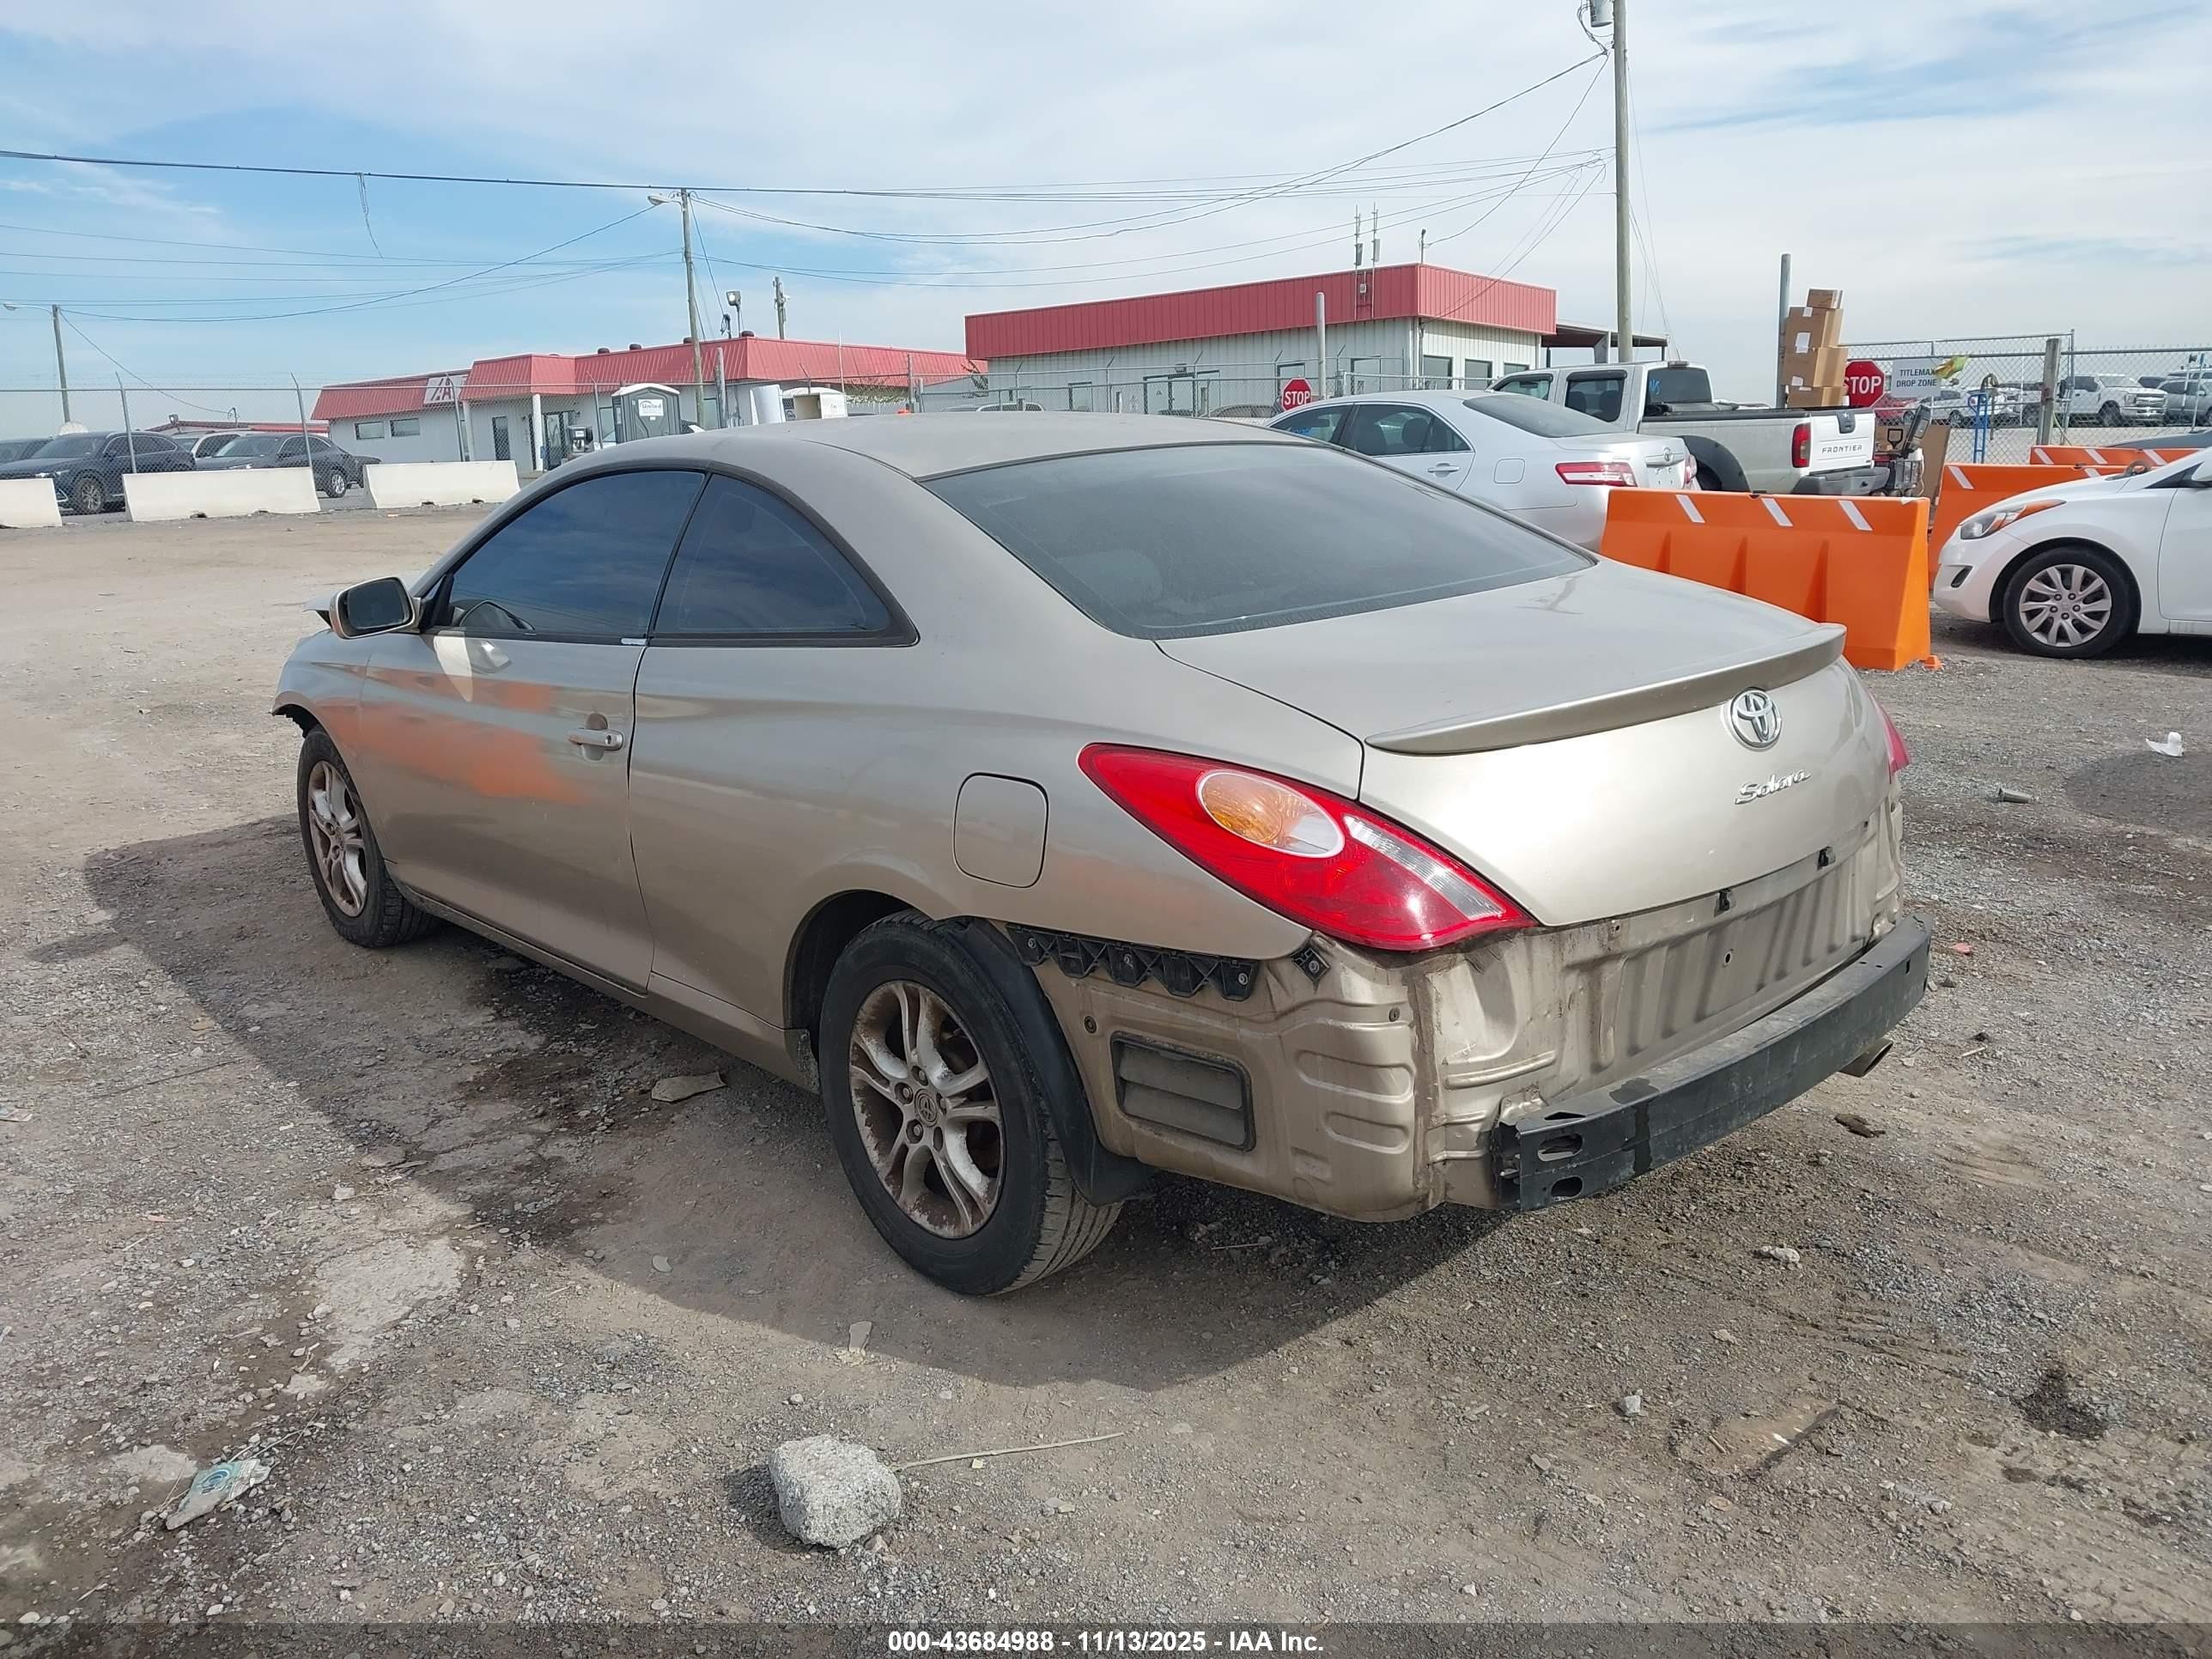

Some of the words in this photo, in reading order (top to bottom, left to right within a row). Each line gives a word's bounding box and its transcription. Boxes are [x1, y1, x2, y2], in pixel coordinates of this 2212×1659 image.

[1899, 368, 1936, 377] TITLEMAX
[1896, 379, 1916, 387] DROP
[1917, 378, 1937, 386] ZONE
[1285, 391, 1310, 405] STOP
[1821, 444, 1863, 454] FRONTIER
[1735, 769, 1812, 805] Solara
